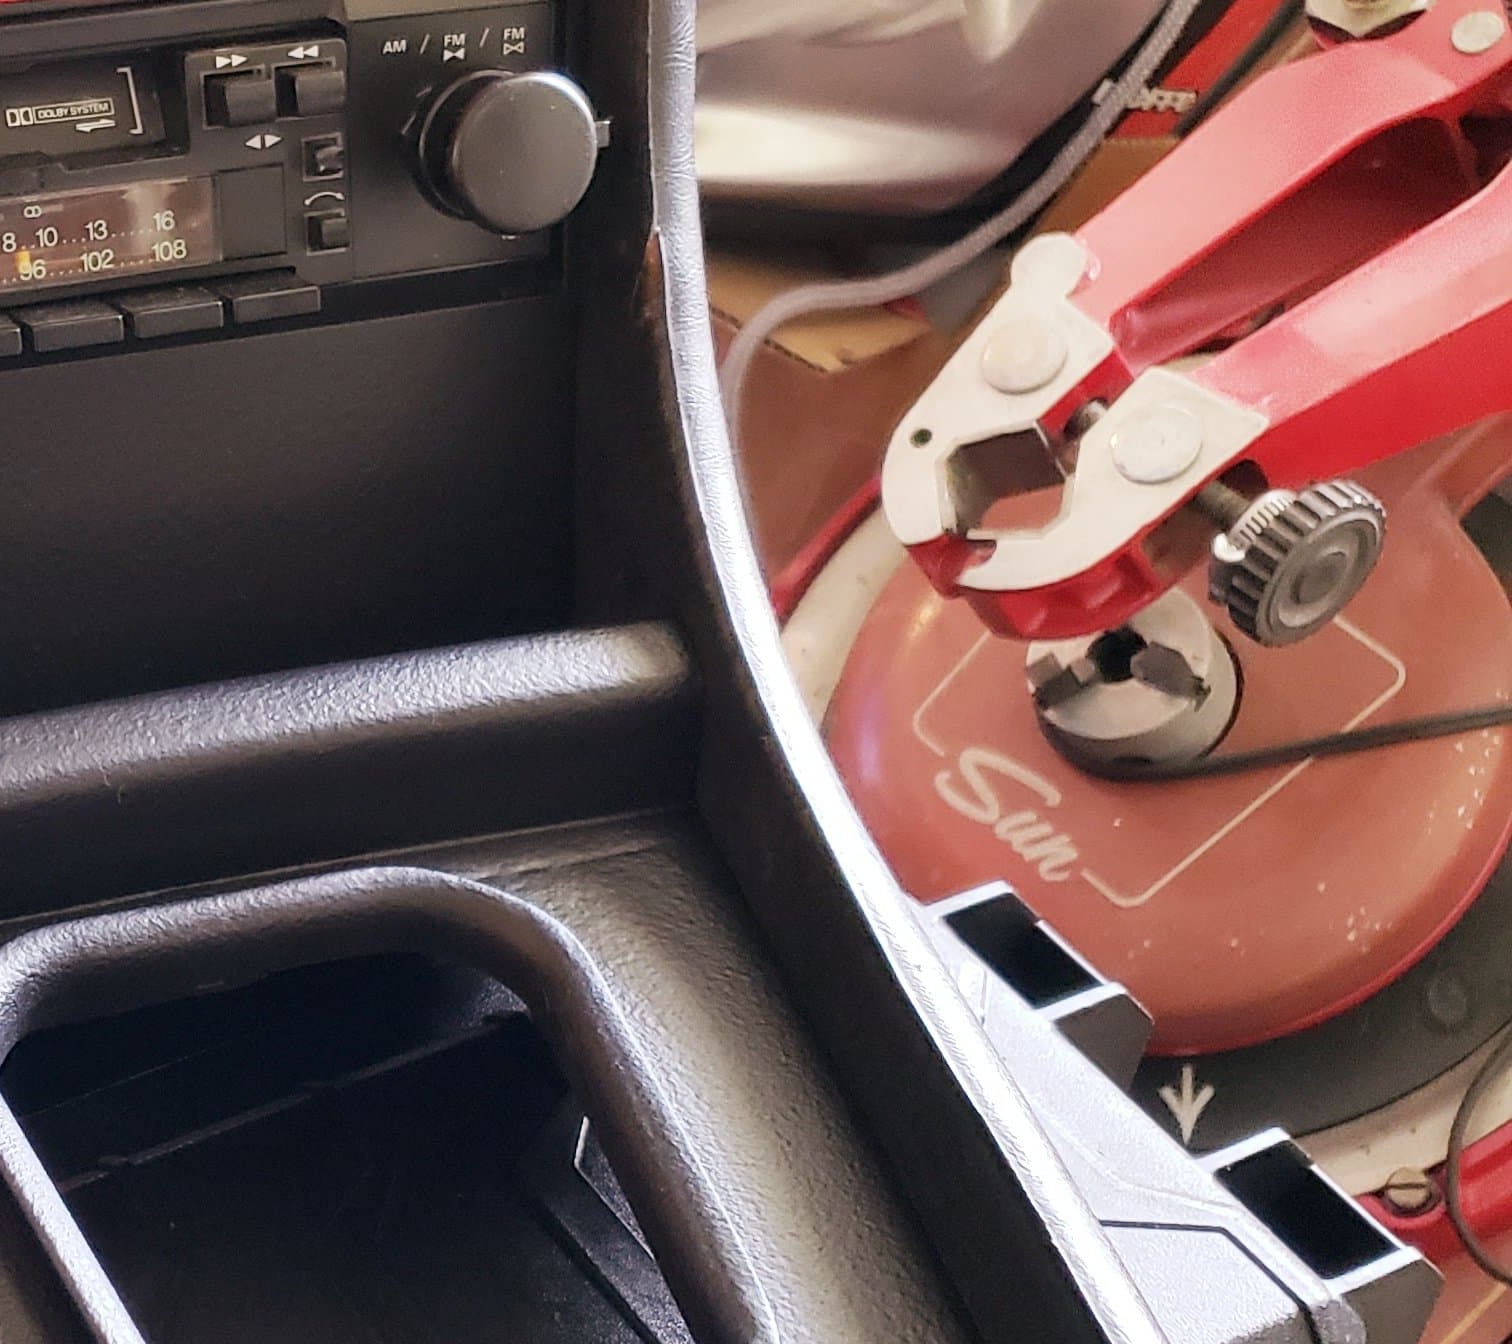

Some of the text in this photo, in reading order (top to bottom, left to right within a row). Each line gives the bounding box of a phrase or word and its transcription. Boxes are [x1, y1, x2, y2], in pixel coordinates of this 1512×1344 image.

[382, 39, 407, 55] AM
[443, 33, 466, 48] FM
[503, 27, 526, 41] FM
[37, 102, 109, 120] DOLBY SYSTEM
[2, 232, 17, 253] 8
[35, 226, 59, 248] 10
[85, 219, 108, 241] 13
[152, 210, 176, 231] 16
[20, 259, 47, 281] 96
[80, 248, 115, 272] 102
[152, 239, 188, 262] 108
[933, 746, 1080, 882] Sun
